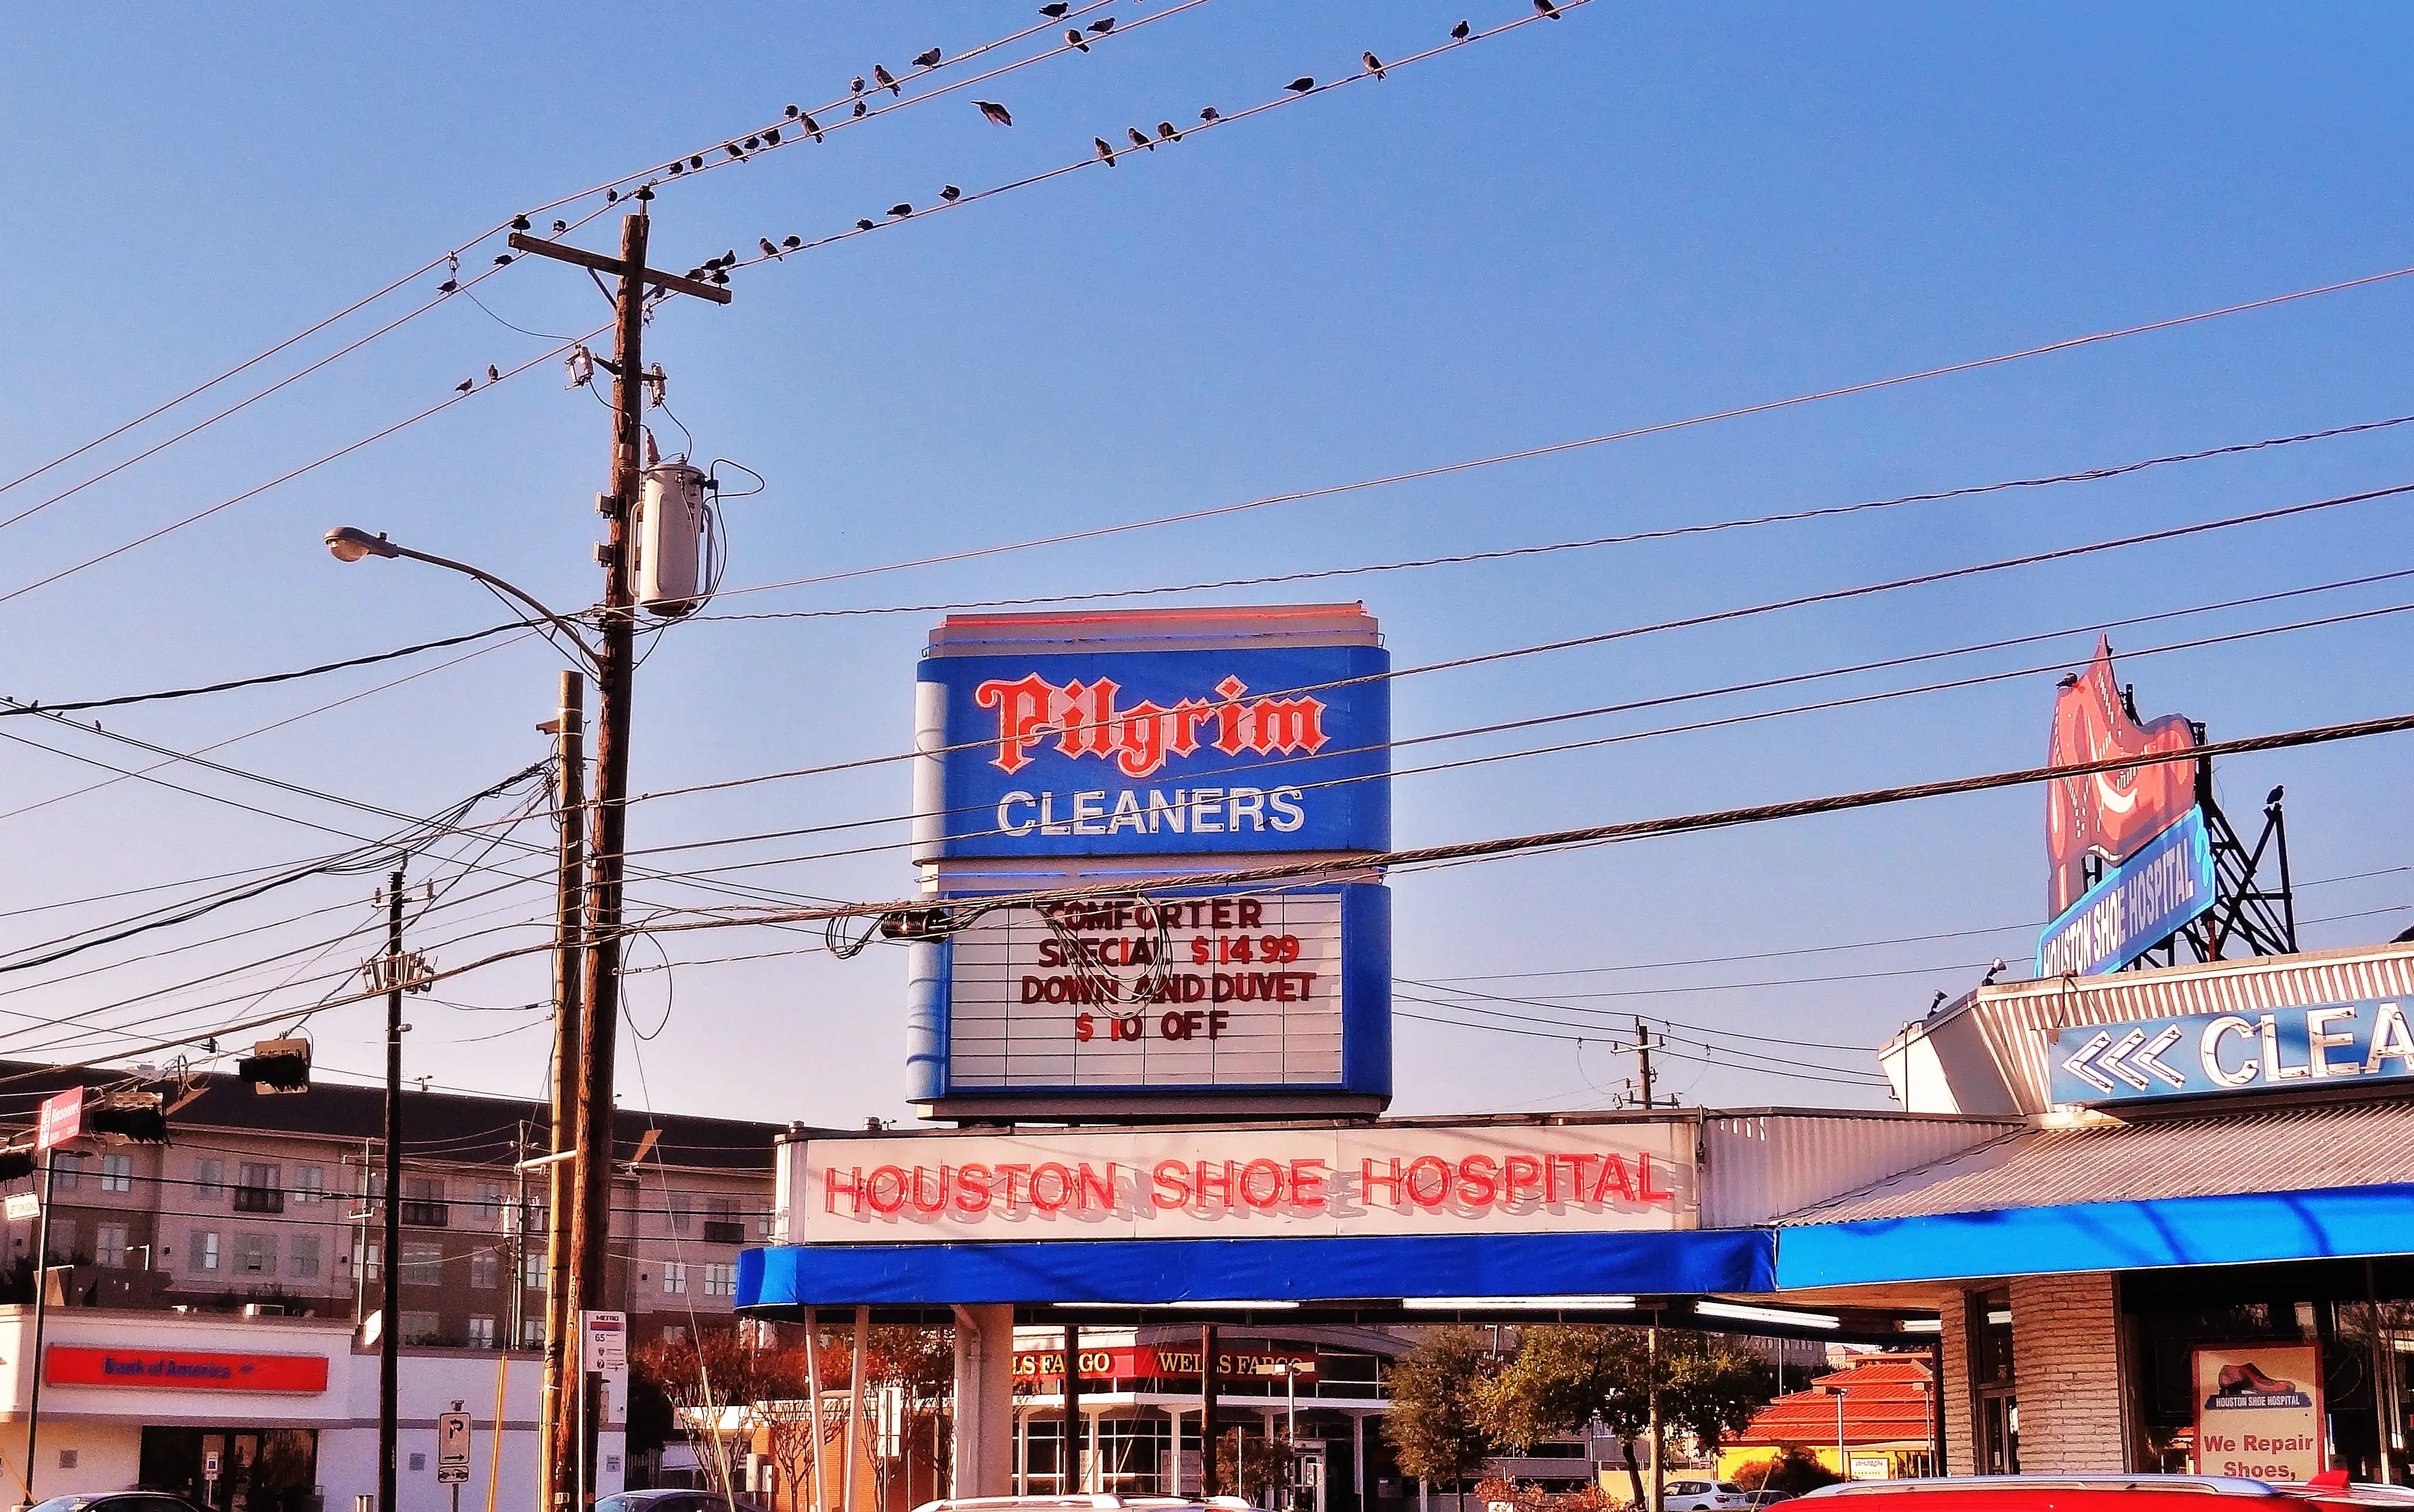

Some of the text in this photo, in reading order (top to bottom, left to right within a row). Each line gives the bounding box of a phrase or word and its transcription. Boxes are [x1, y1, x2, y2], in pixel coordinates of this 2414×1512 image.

[975, 672, 1331, 778] Pilgrim
[997, 786, 1305, 837] CLEANERS
[2044, 837, 2194, 979] HOUSTON SHOE HOSPITAL
[1022, 972, 1317, 1005] DOWN AND DUVET
[1160, 1010, 1229, 1041] OFF
[823, 1152, 1675, 1214] HOUSTON SHOE HOSPITAL
[104, 1356, 143, 1375] Bank
[166, 1360, 231, 1379] America
[1040, 1352, 1110, 1374] FAGO
[1159, 1352, 1232, 1374] WELS
[2216, 1395, 2300, 1407] HOUSTON SHOE HOSPITAL
[2203, 1434, 2313, 1455] We Repair
[2224, 1461, 2296, 1480] Shoes,
